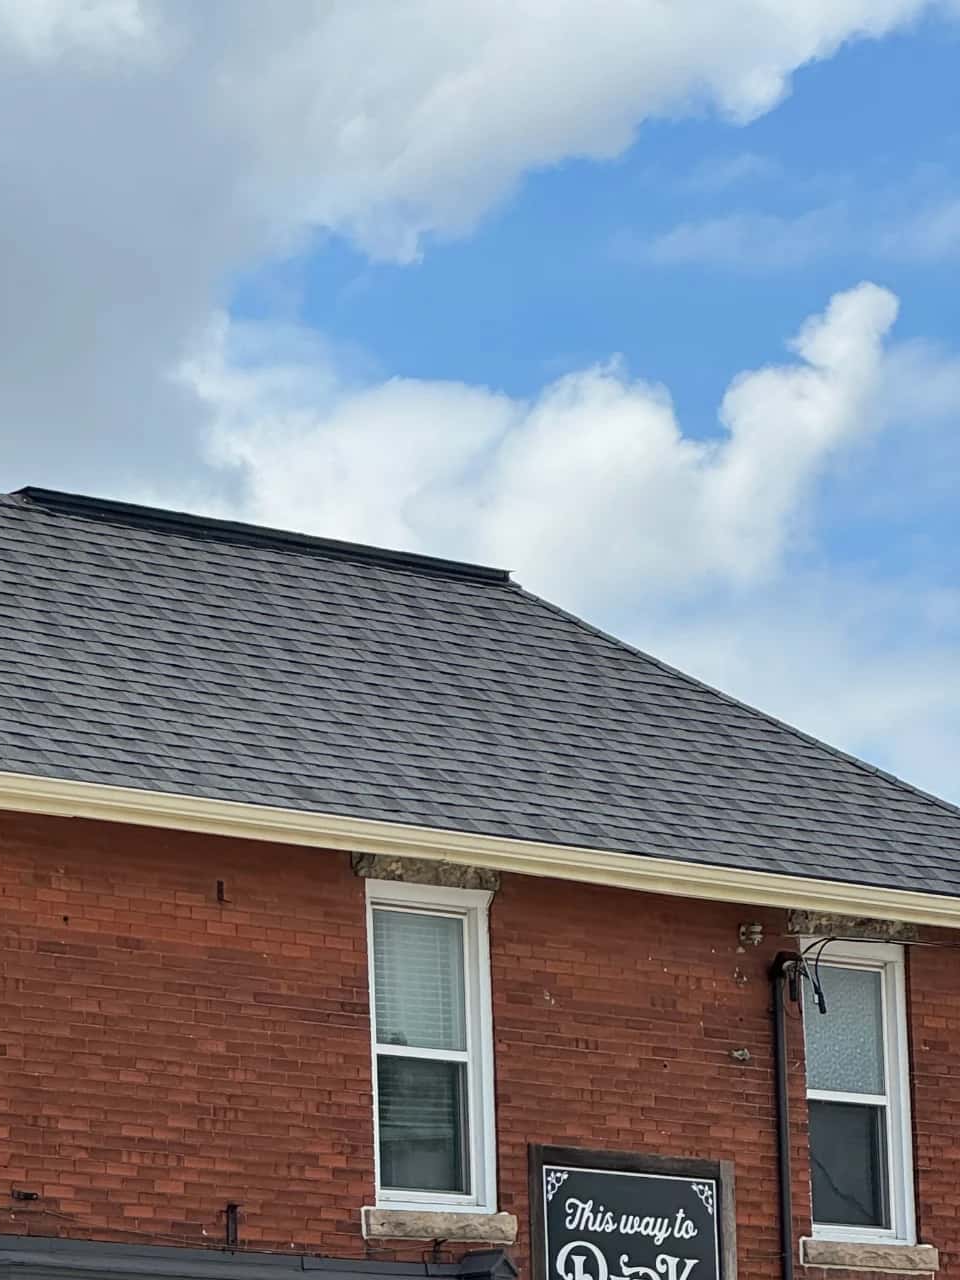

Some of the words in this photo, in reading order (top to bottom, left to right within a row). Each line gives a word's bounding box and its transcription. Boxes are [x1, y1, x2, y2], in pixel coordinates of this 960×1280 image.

[565, 1198, 618, 1233] This
[620, 1212, 672, 1245] way
[674, 1208, 698, 1239] to
